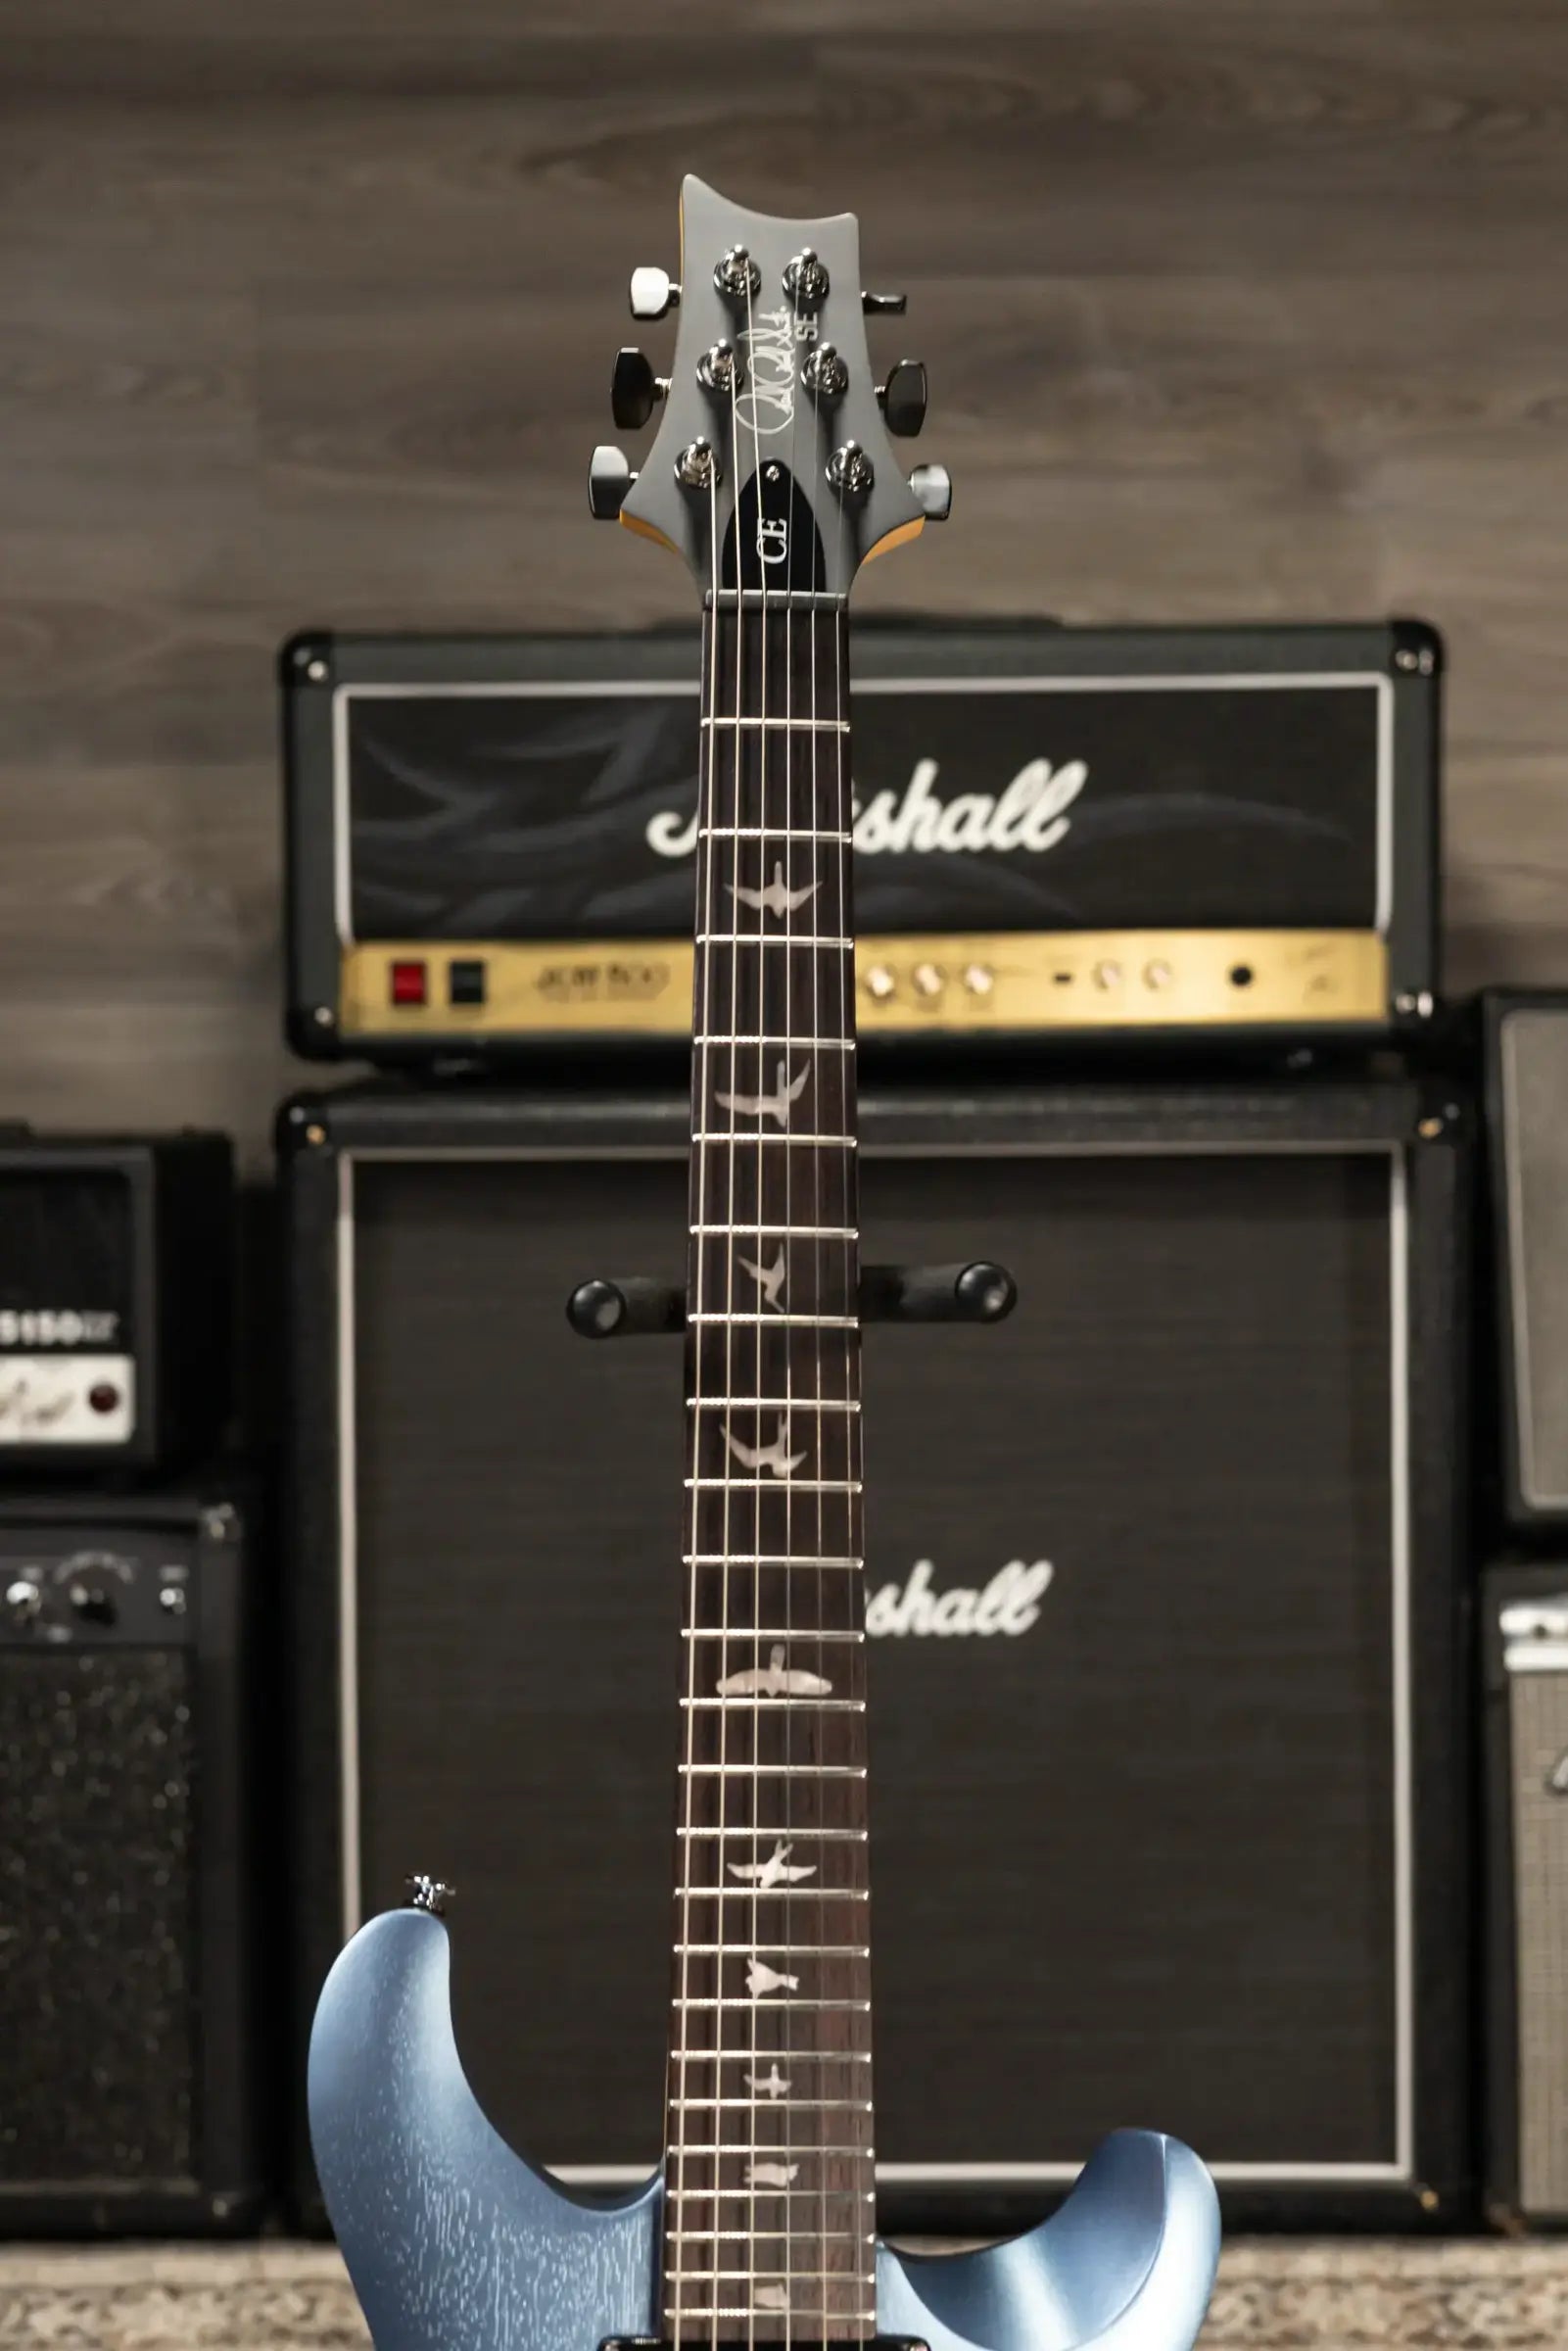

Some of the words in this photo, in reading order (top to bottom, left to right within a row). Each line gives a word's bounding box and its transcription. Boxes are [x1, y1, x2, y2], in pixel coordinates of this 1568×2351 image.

[794, 312, 818, 341] SE
[757, 518, 786, 563] CE
[645, 757, 1088, 856] shall
[865, 1559, 1053, 1637] shall
